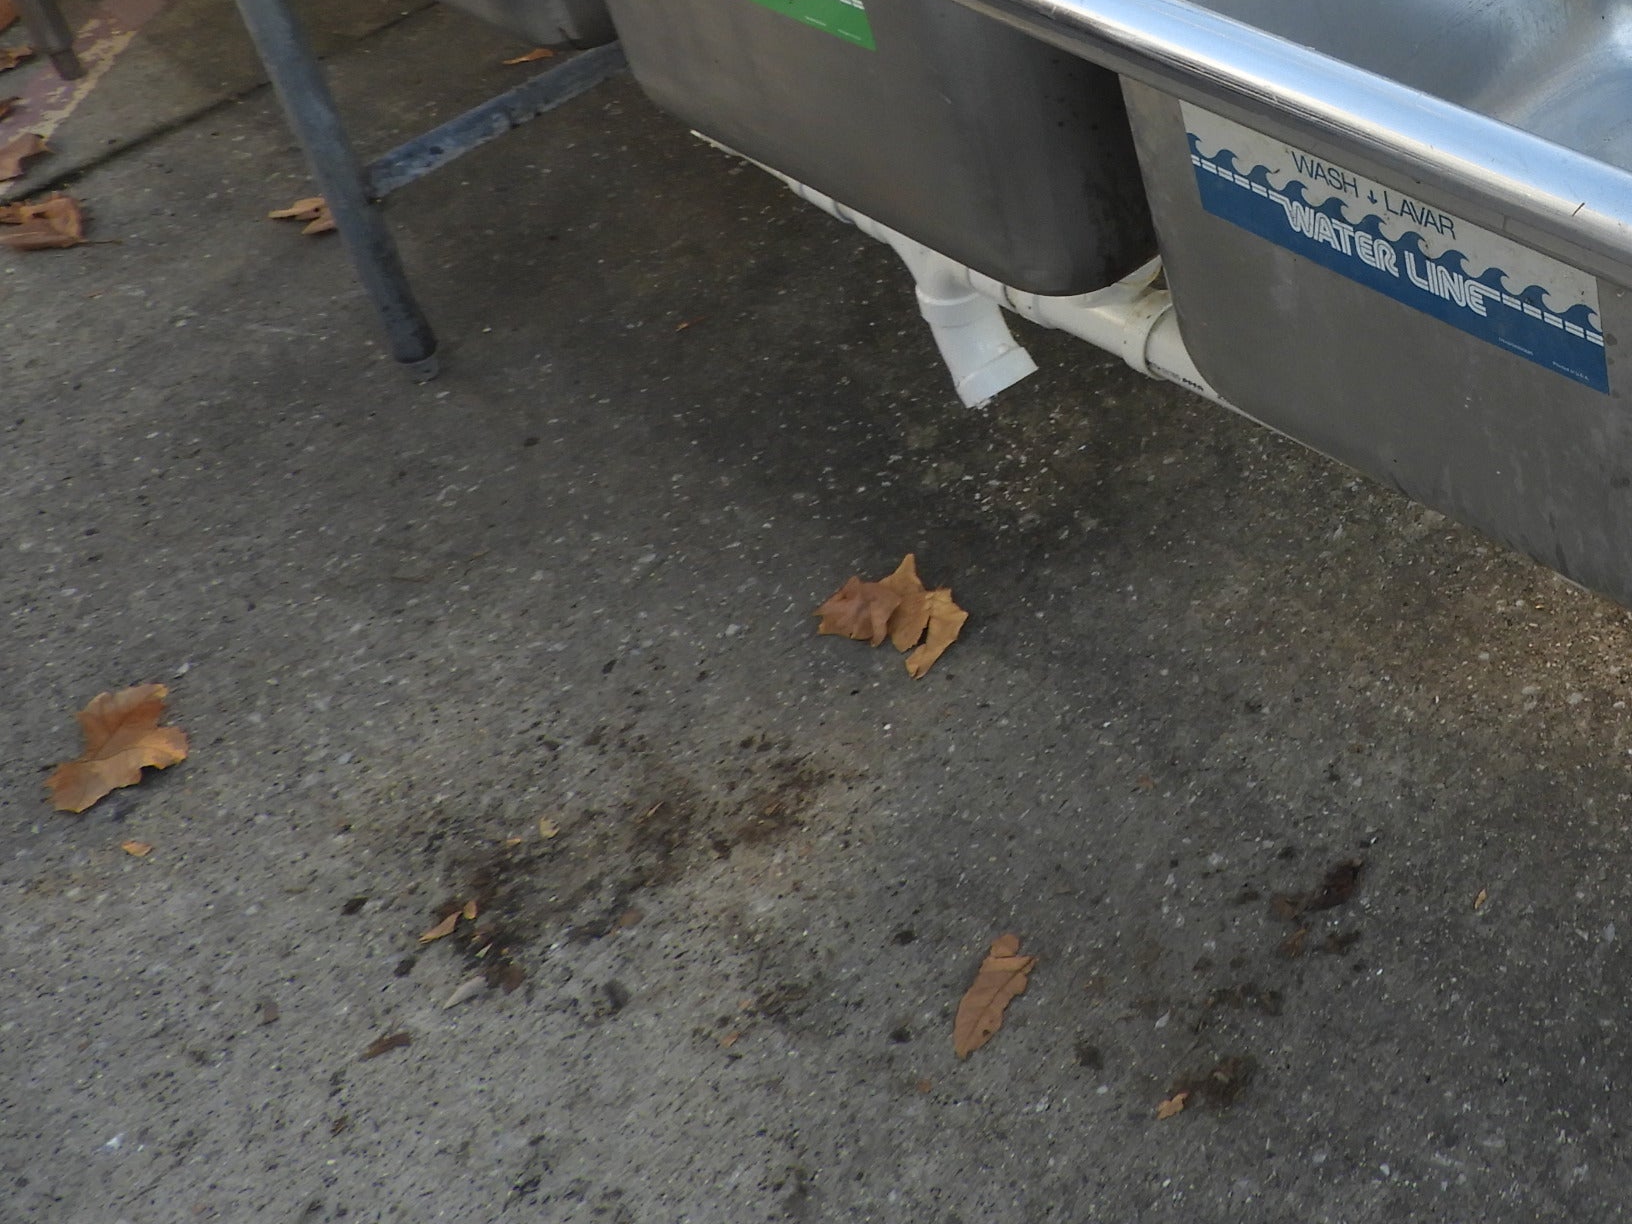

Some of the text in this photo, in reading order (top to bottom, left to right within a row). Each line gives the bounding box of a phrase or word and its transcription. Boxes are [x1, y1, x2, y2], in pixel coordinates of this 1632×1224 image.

[1289, 150, 1456, 240] WASH LAVAR
[1270, 193, 1501, 317] WATER LINE
